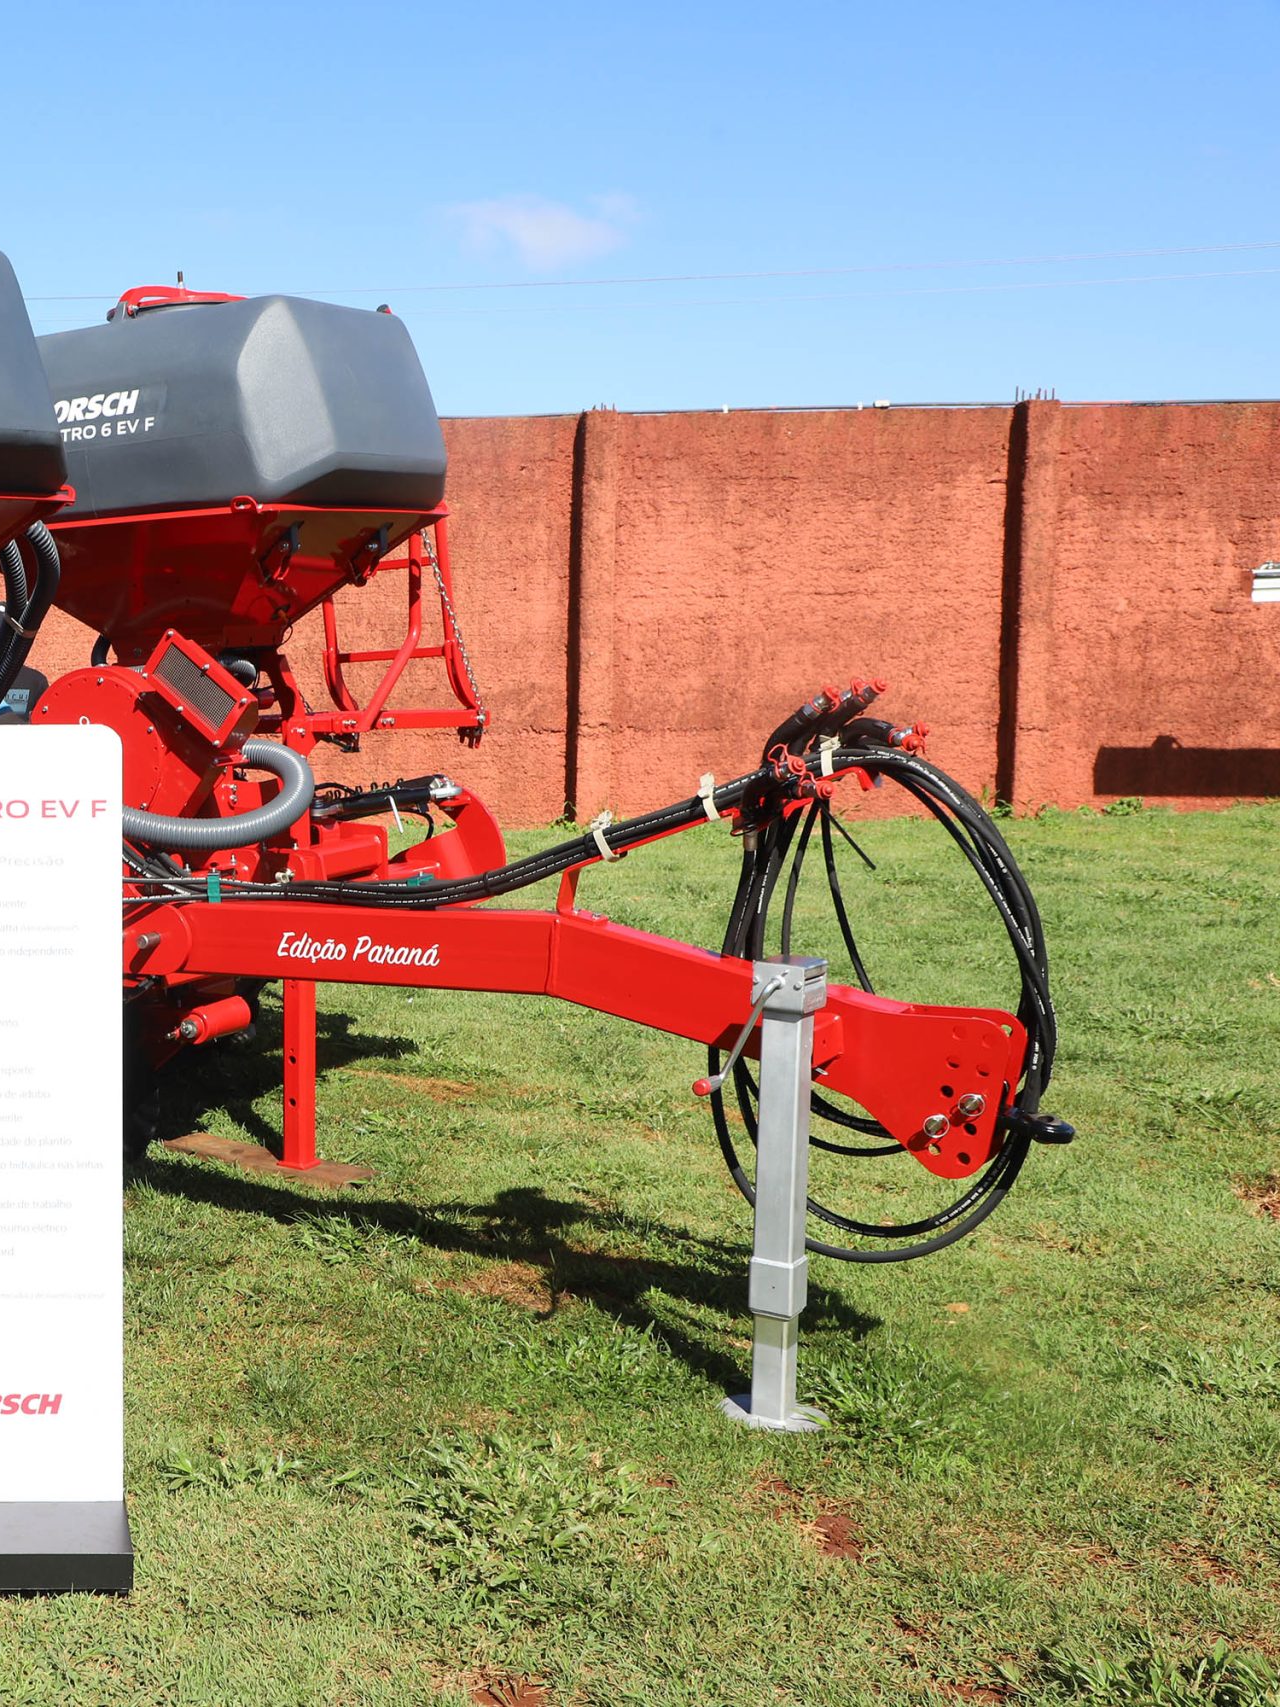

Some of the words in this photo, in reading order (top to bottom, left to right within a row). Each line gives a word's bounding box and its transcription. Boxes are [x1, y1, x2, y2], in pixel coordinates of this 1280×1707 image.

[53, 389, 140, 424] ORSCH
[100, 422, 112, 437] 6
[116, 419, 140, 435] EV
[144, 416, 155, 432] F
[40, 799, 81, 819] EV
[90, 799, 108, 819] F
[276, 931, 348, 963] Edição
[352, 935, 440, 967] Paraná
